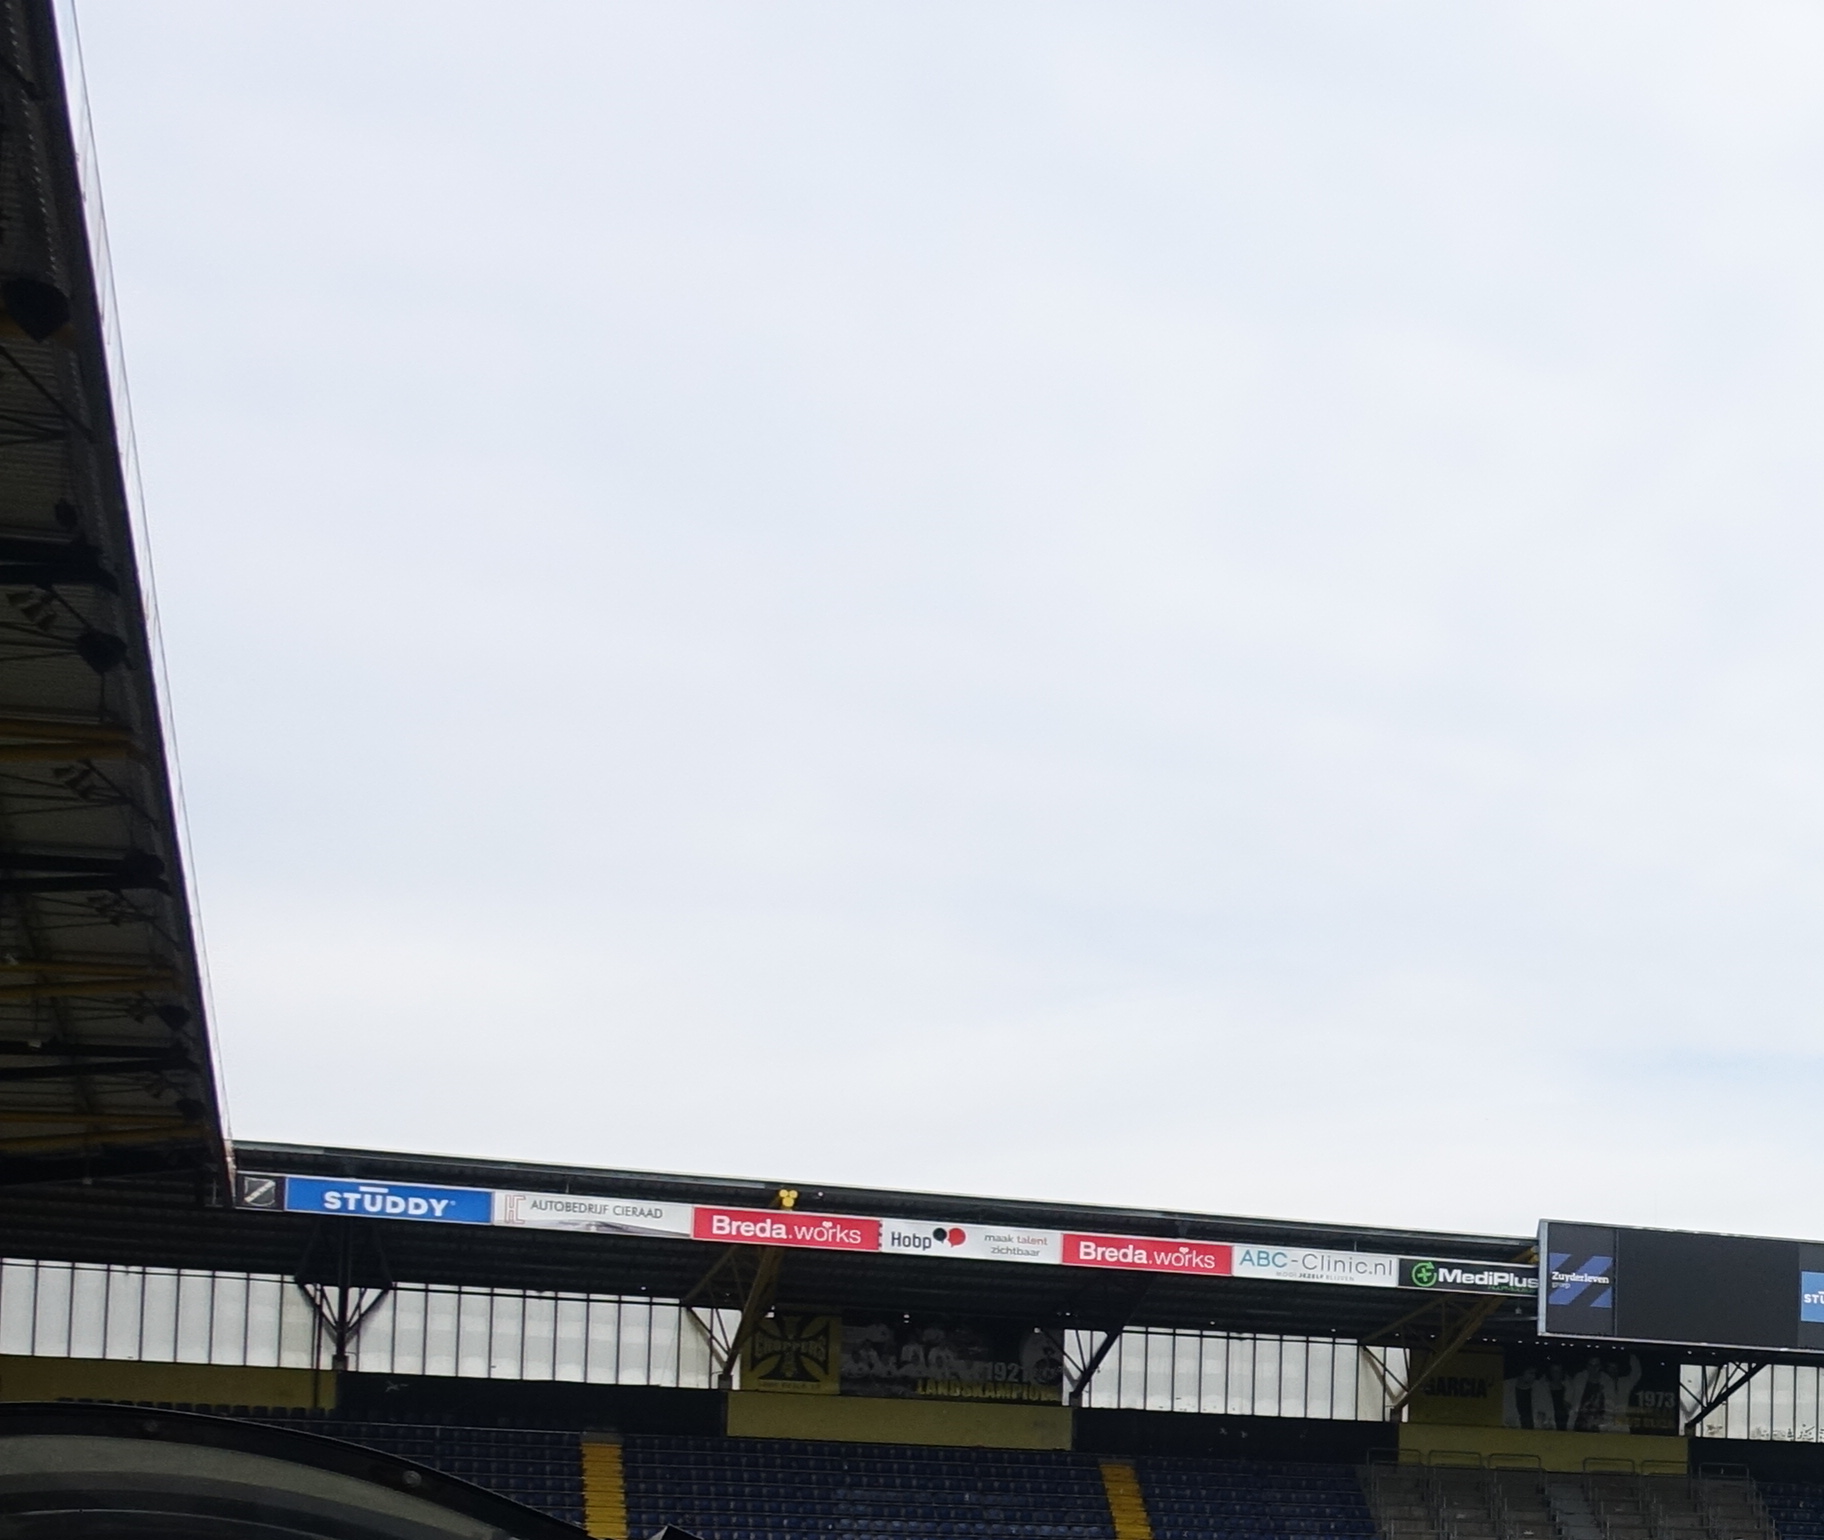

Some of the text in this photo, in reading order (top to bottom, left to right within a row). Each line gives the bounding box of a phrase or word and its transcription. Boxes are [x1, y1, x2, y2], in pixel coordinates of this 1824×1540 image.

[530, 1200, 664, 1219] AUTOBEDRIJF CIERAAD
[712, 1215, 862, 1244] Breda.works
[891, 1231, 932, 1250] Hobp
[984, 1234, 1048, 1246] maak talent
[990, 1246, 1040, 1257] zichtbaar
[1079, 1241, 1216, 1269] Breda.works
[1438, 1267, 1539, 1288] MediPlus
[1635, 1390, 1676, 1408] 1973
